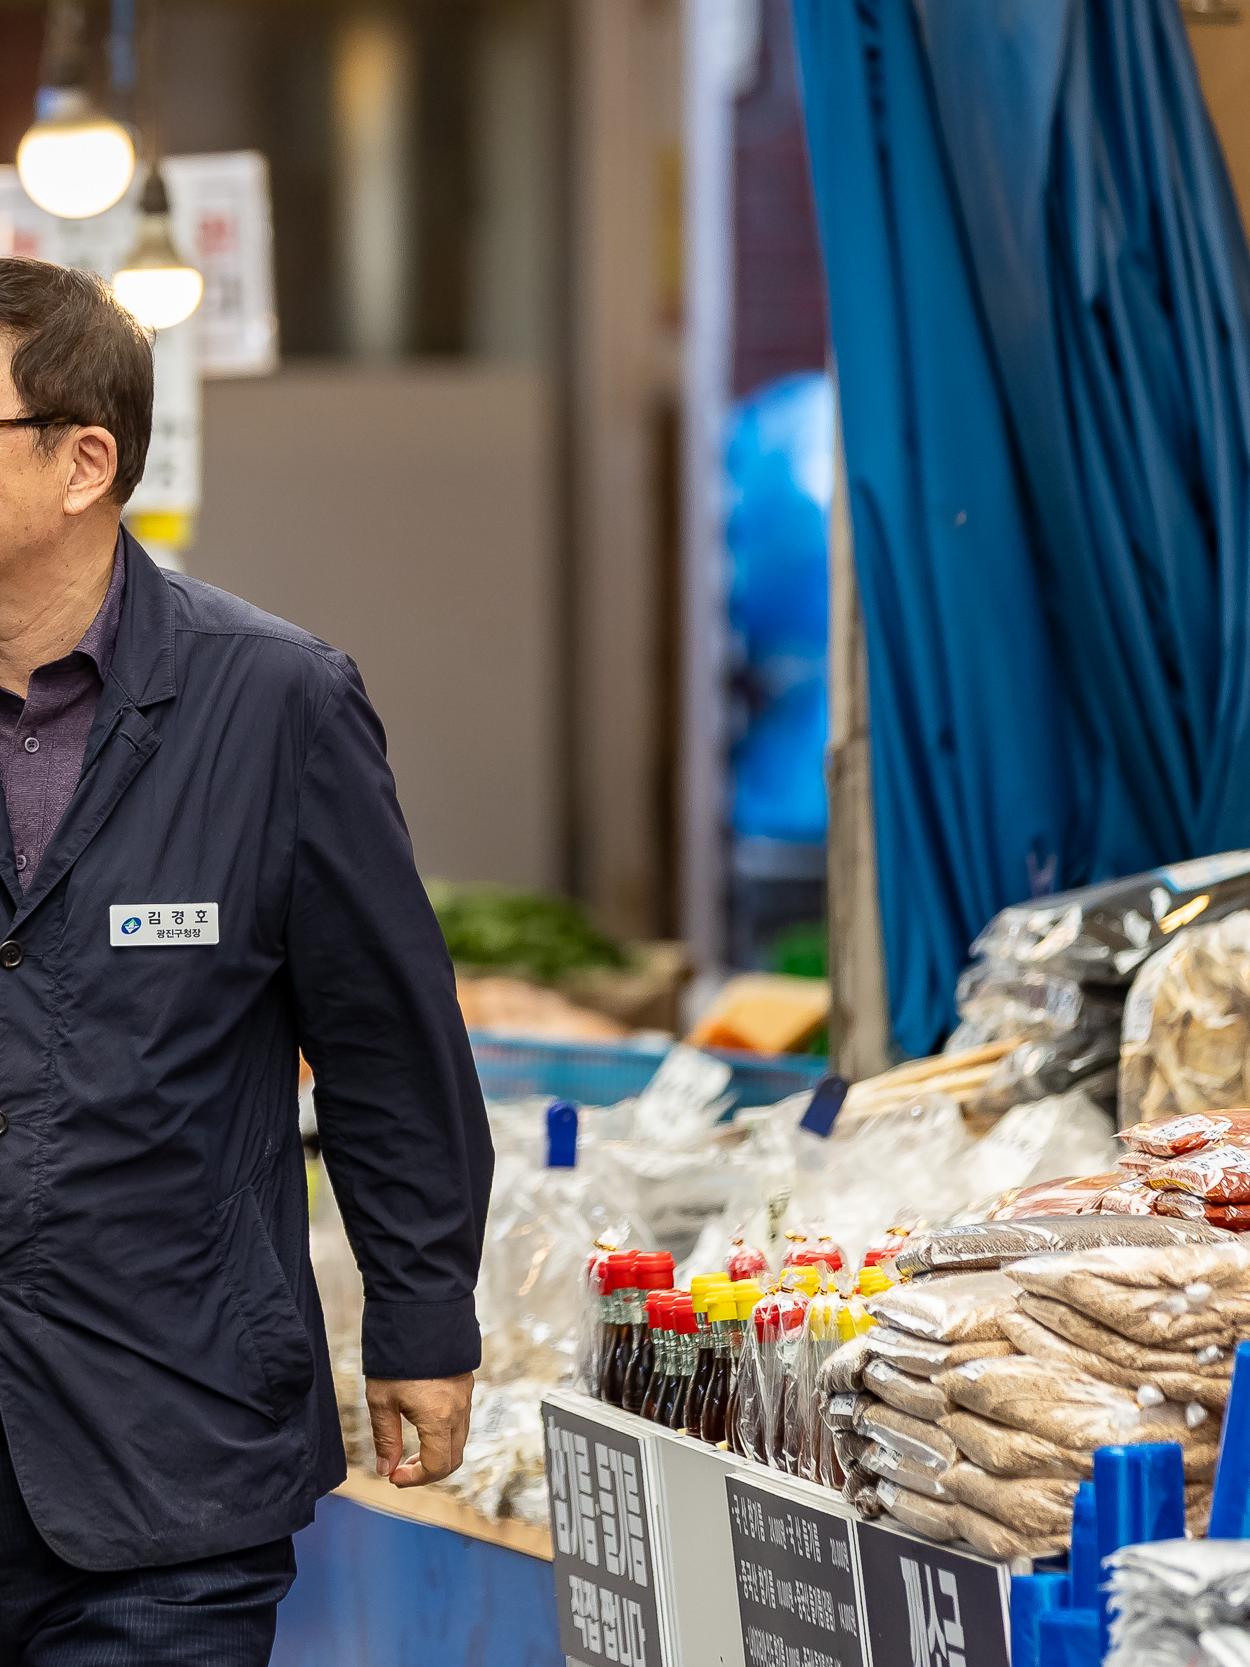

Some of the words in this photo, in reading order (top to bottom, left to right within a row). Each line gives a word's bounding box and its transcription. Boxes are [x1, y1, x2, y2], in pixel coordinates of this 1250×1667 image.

[156, 928, 201, 939] 광진구청장
[547, 1416, 600, 1567] 참기름
[595, 1442, 648, 1588] 들기름
